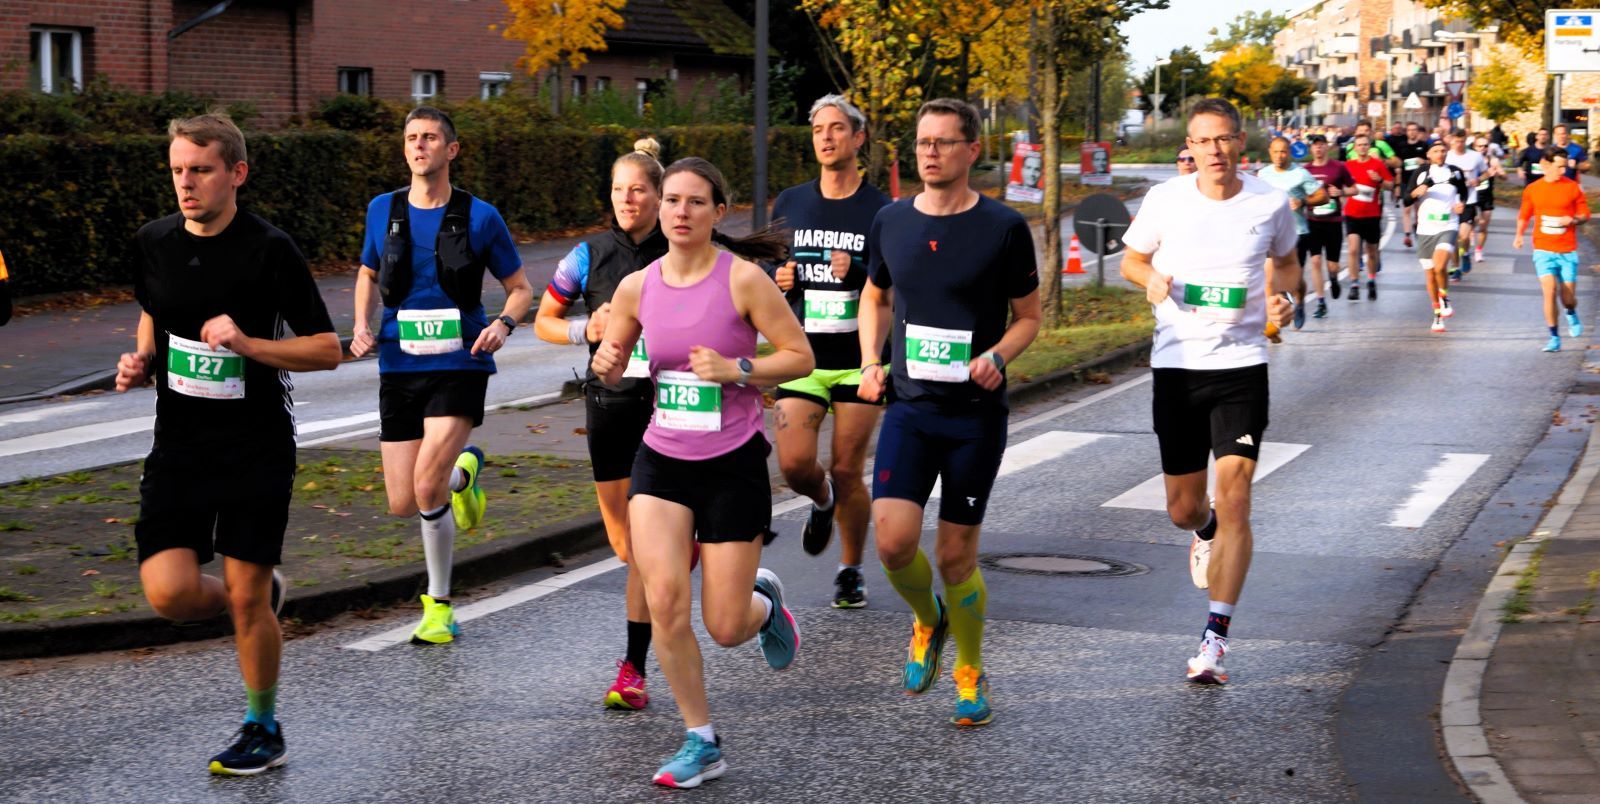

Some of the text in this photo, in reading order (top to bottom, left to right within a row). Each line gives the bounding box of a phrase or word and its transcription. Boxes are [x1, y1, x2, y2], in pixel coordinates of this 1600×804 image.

[794, 229, 866, 251] HARBURG
[797, 263, 844, 283] BASK
[1200, 286, 1230, 303] 251
[414, 321, 443, 337] 107
[918, 339, 951, 360] 252
[187, 354, 224, 375] 127
[668, 385, 700, 407] 126
